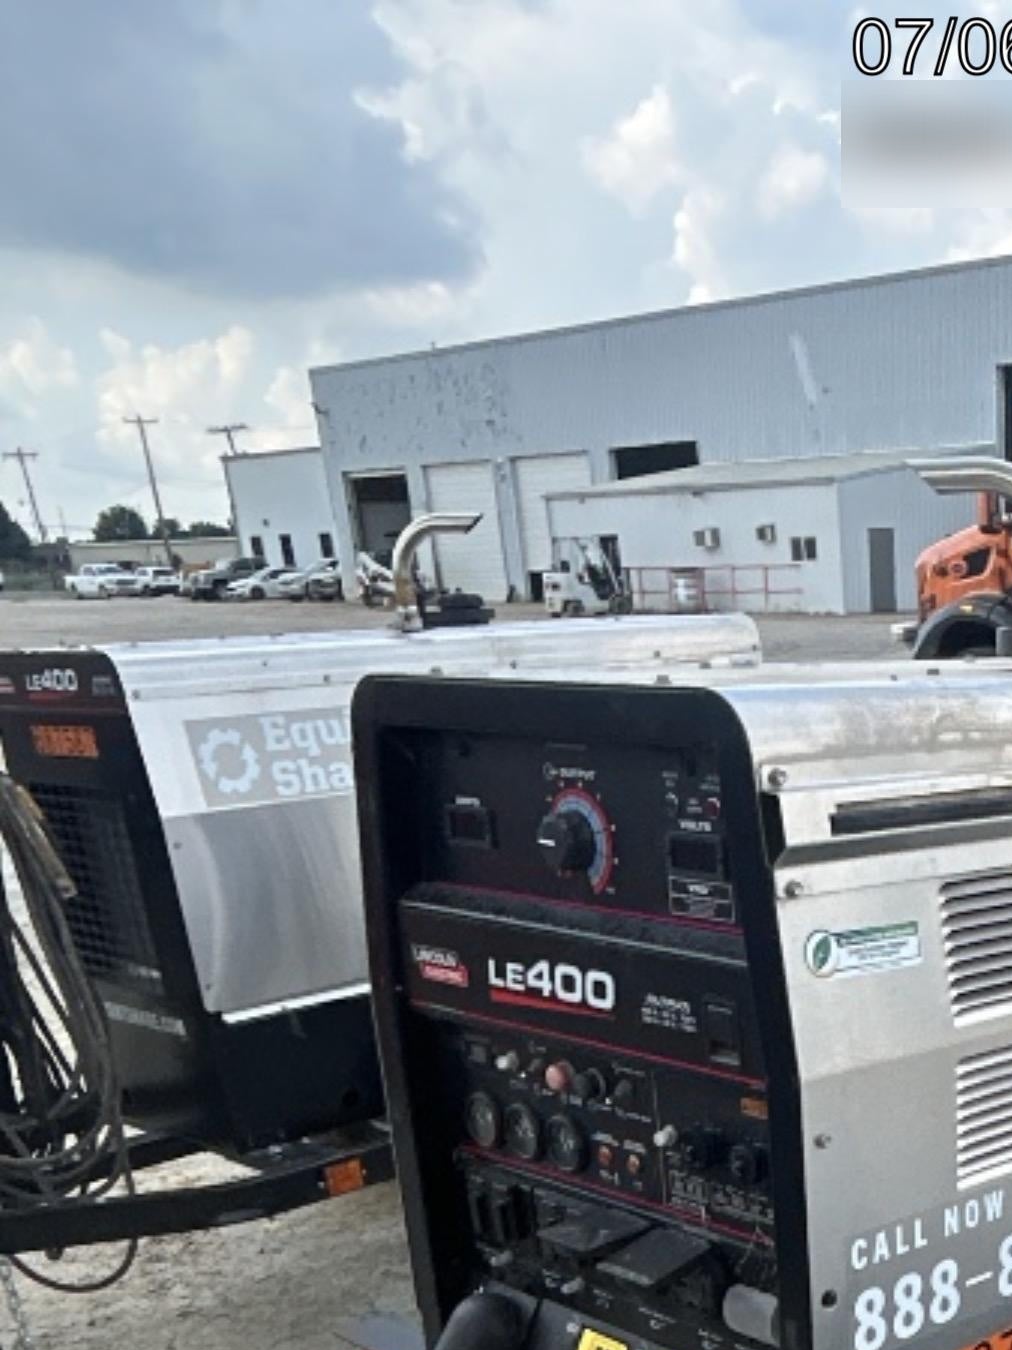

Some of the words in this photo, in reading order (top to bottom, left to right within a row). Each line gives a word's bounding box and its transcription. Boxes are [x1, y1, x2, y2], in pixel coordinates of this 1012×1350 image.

[487, 957, 616, 1011] LE400
[850, 1217, 928, 1271] CALL
[943, 1190, 1006, 1238] NOW
